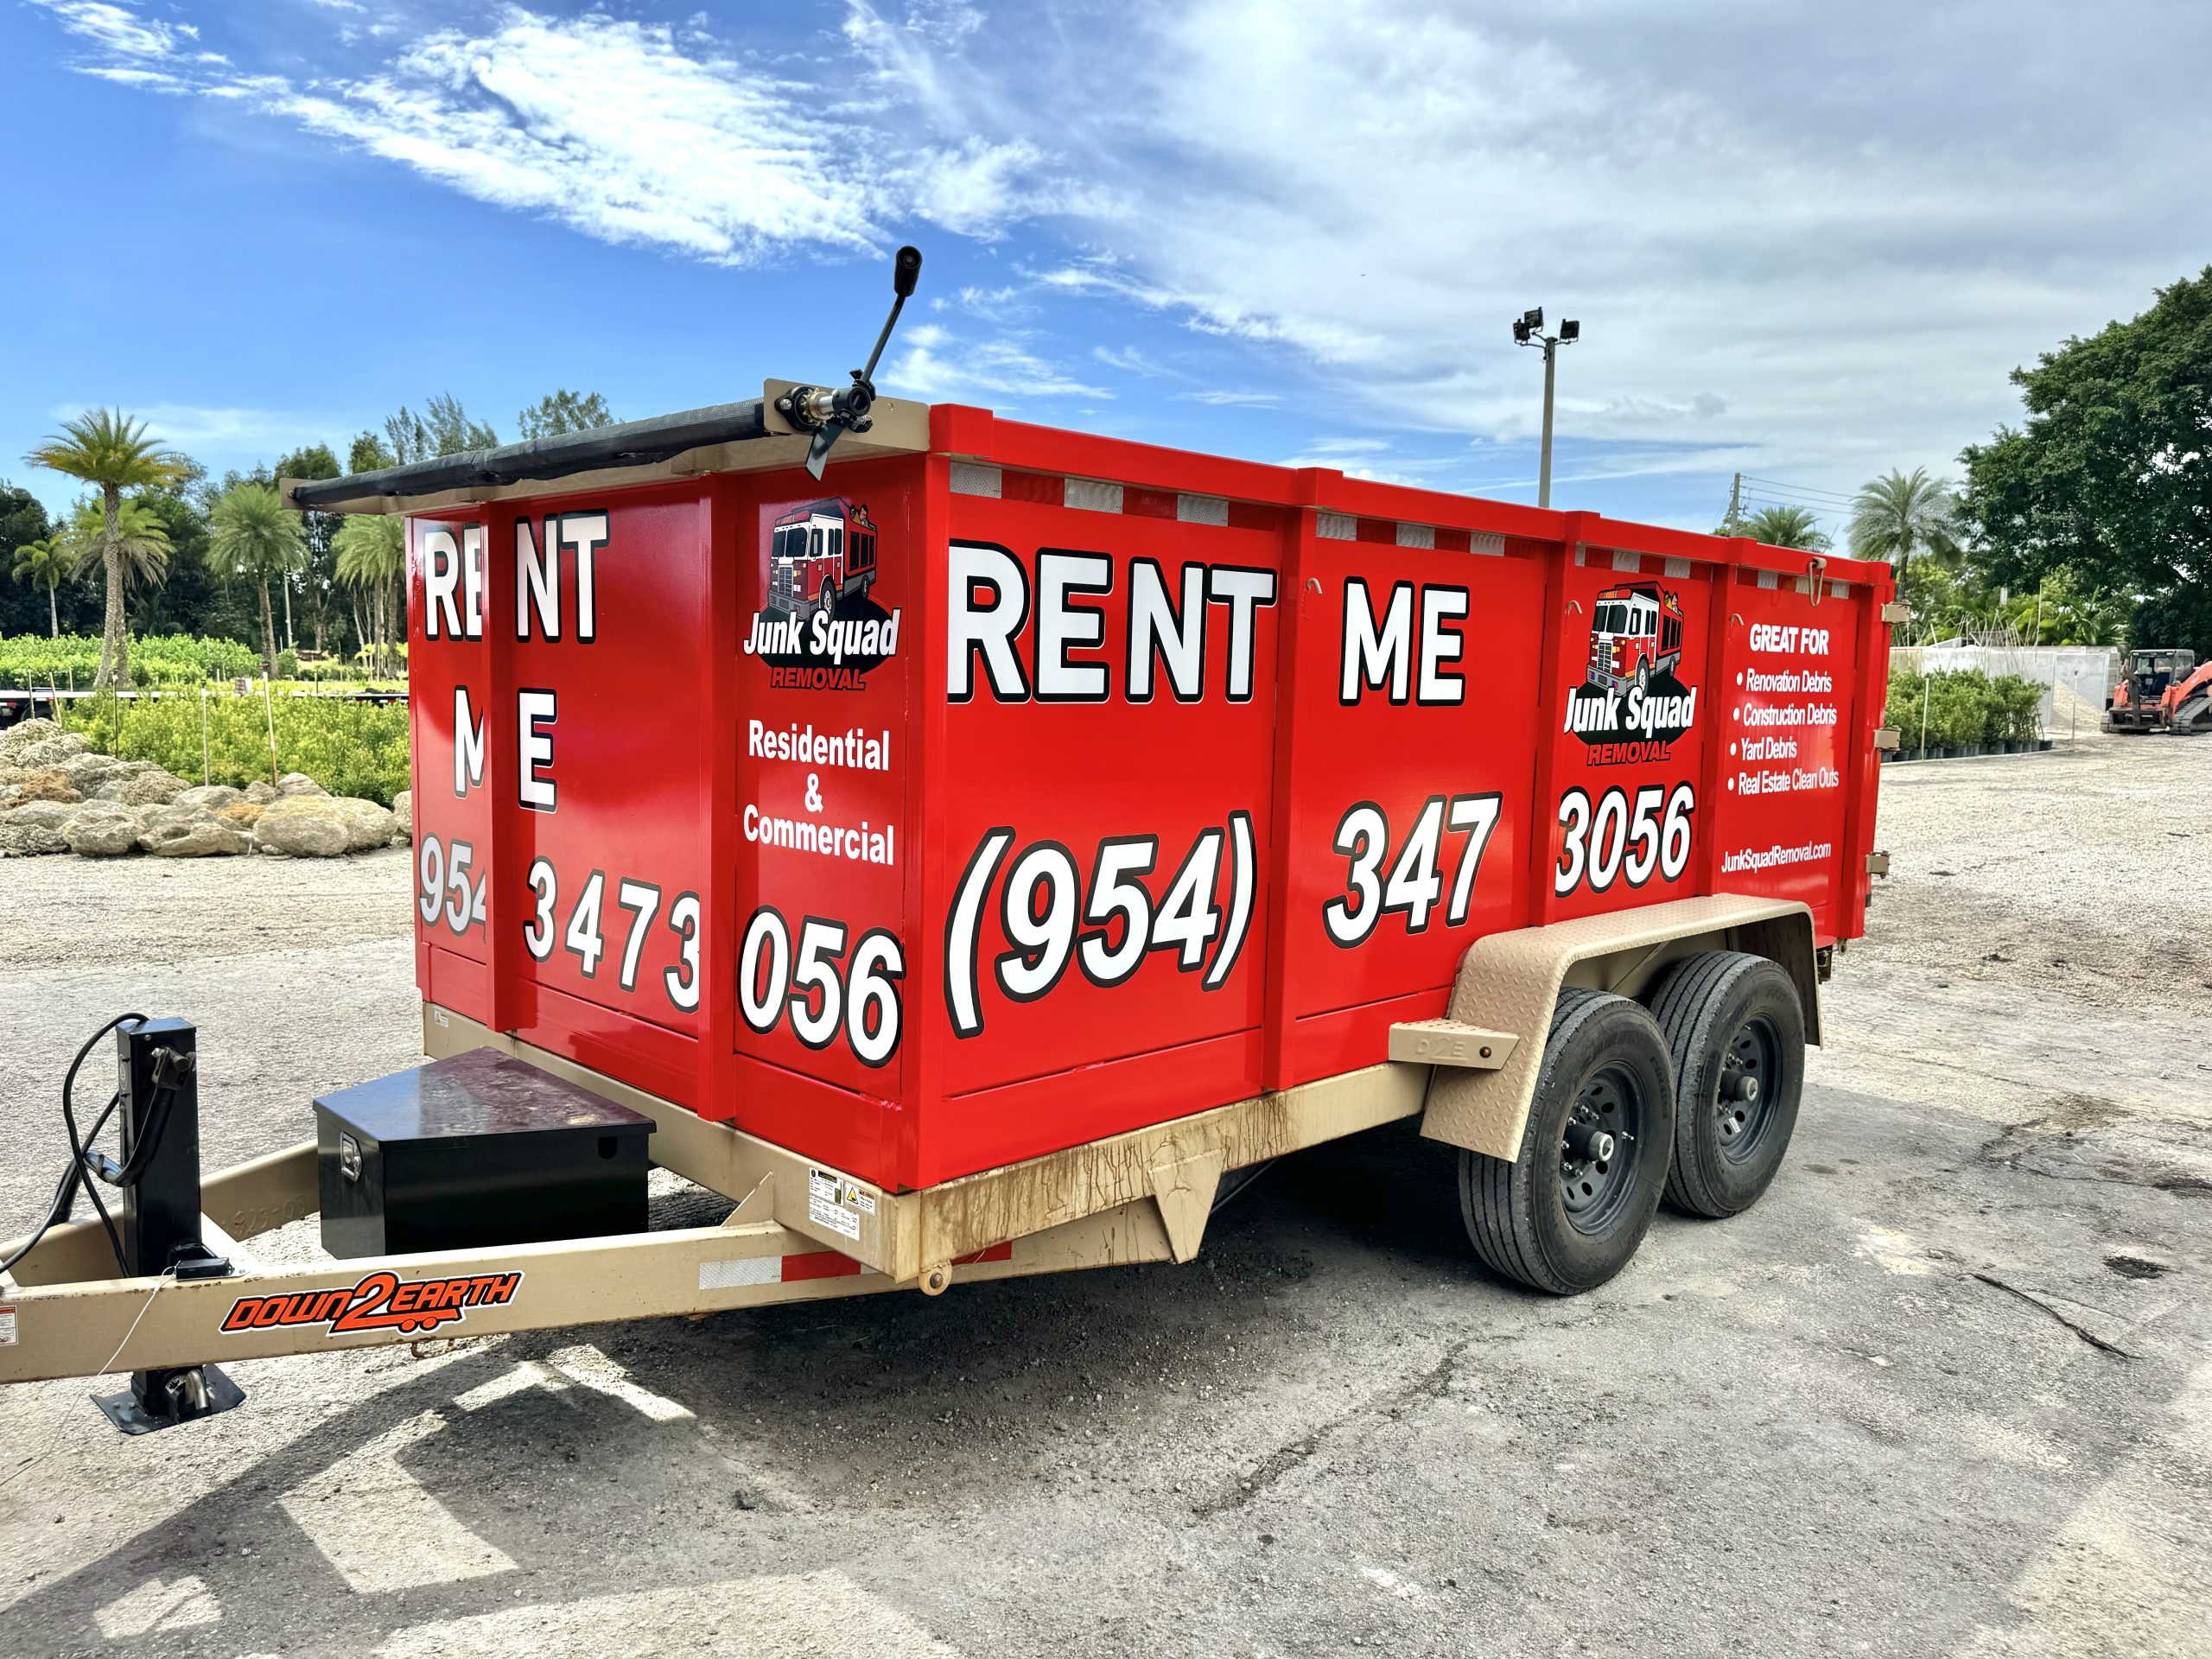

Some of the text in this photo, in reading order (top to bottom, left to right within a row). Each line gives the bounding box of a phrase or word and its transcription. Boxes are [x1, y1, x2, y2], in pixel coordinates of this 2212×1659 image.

[743, 607, 900, 664] Junk Squad
[947, 537, 1469, 706] RENT ME
[1749, 623, 1829, 655] GREAT FOR
[771, 666, 866, 690] REMOVAL
[1746, 668, 1833, 693] Renovation Debris
[1564, 686, 1697, 740] Junk Squad
[1743, 702, 1837, 727] Construction Debris
[748, 719, 890, 771] Residential
[1586, 740, 1670, 766] REMOVAL
[1740, 736, 1797, 761] Yard Debris
[804, 772, 823, 813] &
[1738, 766, 1840, 795] Real Estate Clean Outs
[743, 804, 894, 866] Commercial
[1720, 842, 1831, 873] JunkSquadRemoval.com
[944, 780, 1695, 1039] (954) 347 3056
